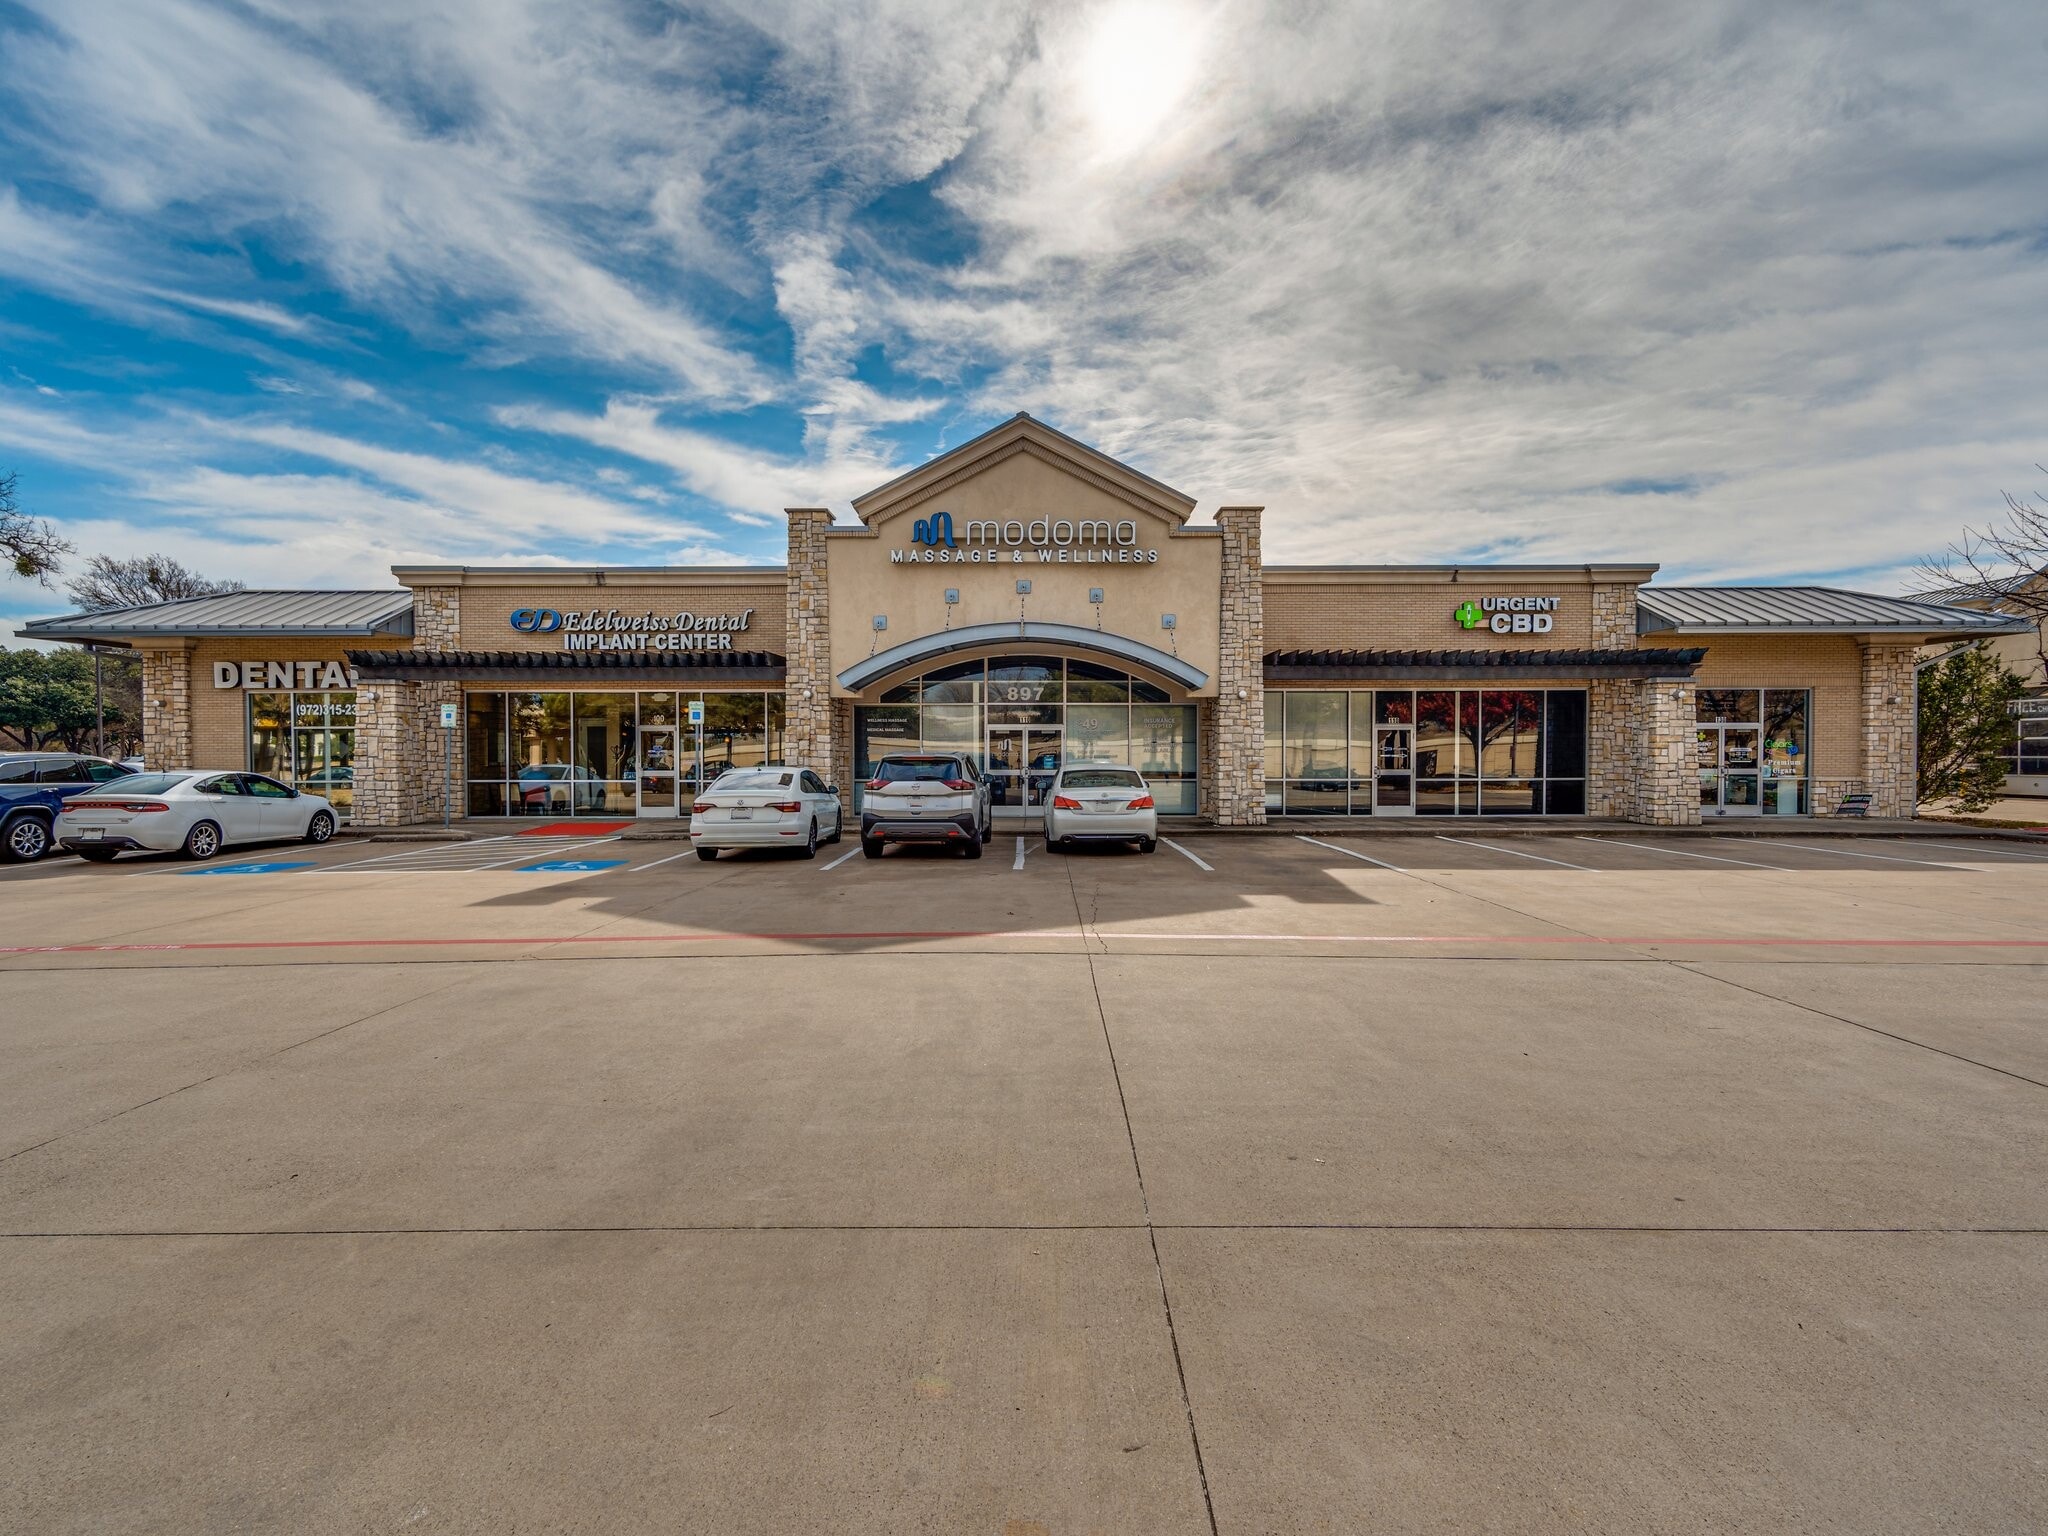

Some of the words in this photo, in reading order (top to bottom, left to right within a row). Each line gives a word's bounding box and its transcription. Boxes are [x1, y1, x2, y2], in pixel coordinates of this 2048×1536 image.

[966, 513, 1137, 546] modoma
[890, 549, 998, 563] MASSAGE
[1012, 549, 1023, 563] &
[1037, 549, 1159, 563] WELLNESS
[1481, 596, 1561, 611] URGENT
[562, 609, 670, 632] Edelweiss
[673, 608, 754, 632] Dental
[1489, 612, 1554, 634] CBD
[563, 633, 650, 650] IMPLANT
[654, 633, 733, 650] CENTER
[1006, 686, 1045, 701] 897
